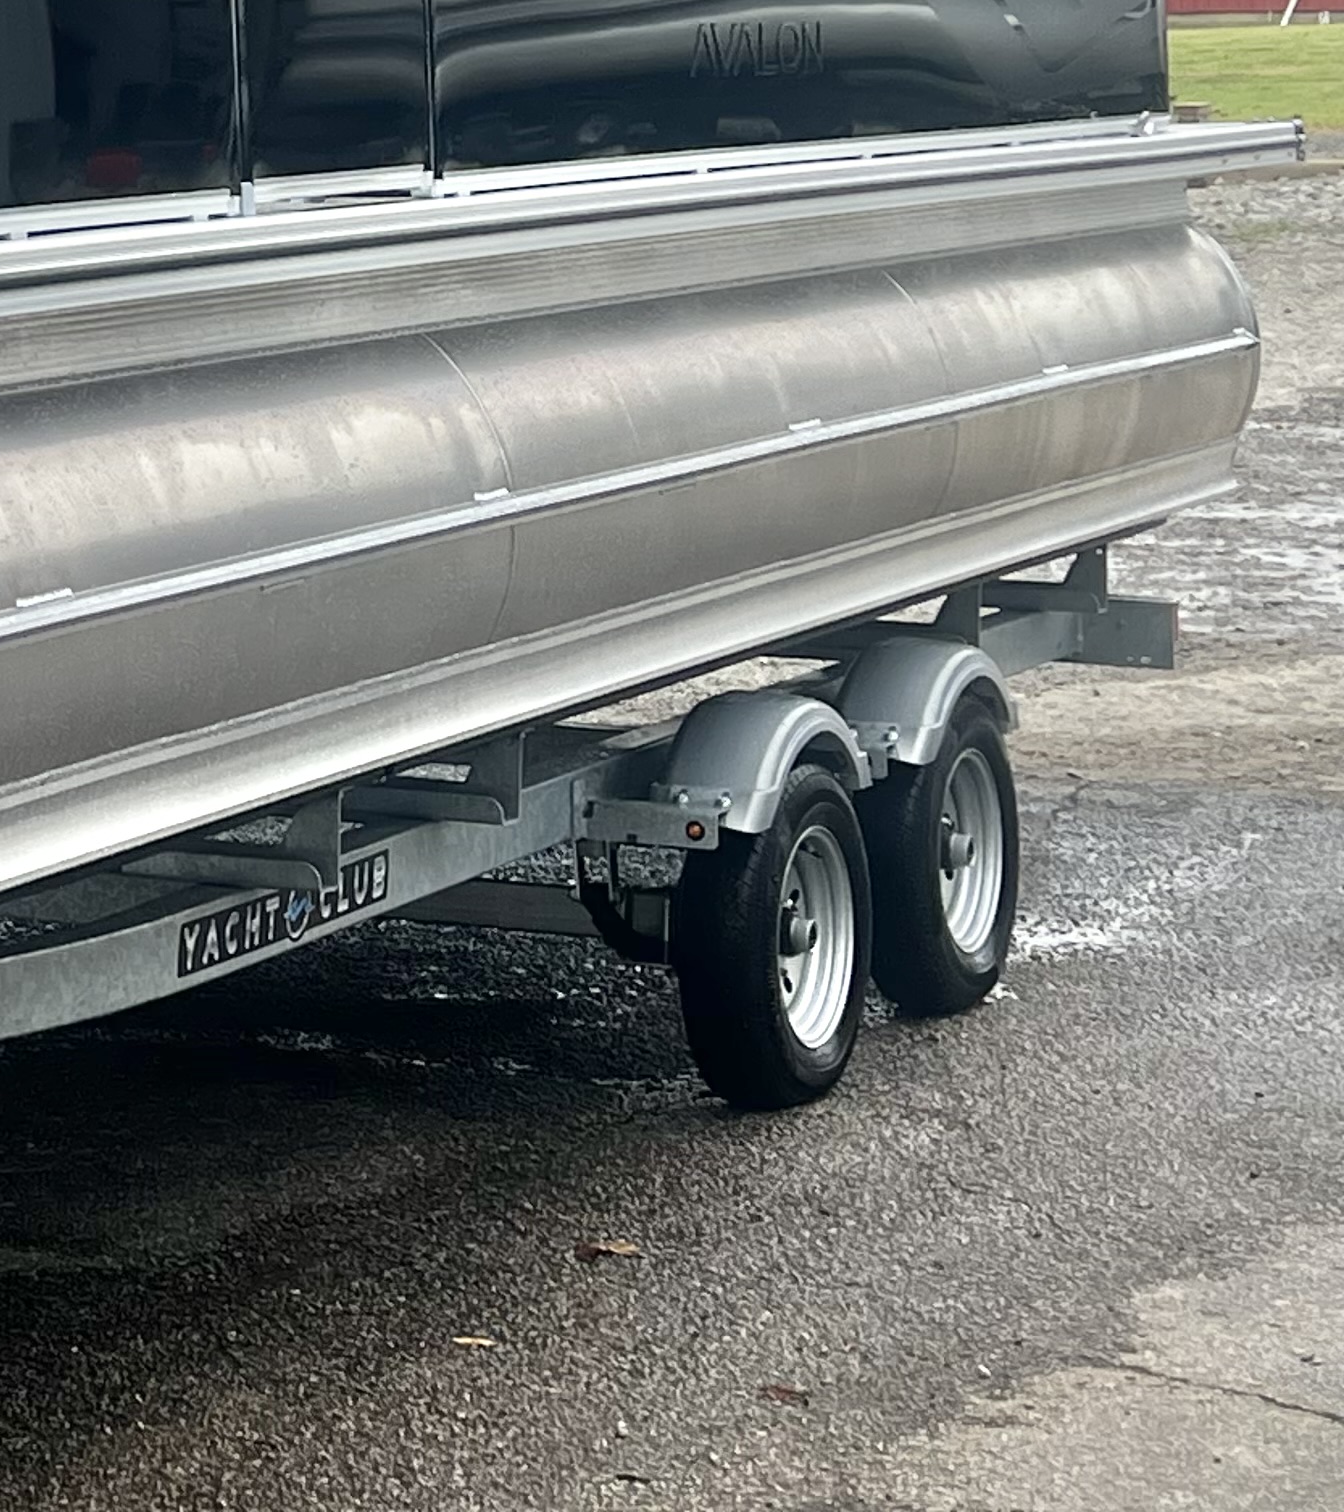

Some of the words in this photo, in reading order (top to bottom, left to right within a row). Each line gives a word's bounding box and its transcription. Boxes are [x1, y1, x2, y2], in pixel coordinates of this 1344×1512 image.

[688, 20, 825, 78] AVALON
[183, 895, 281, 972] YACHT
[319, 854, 387, 919] CLUB
